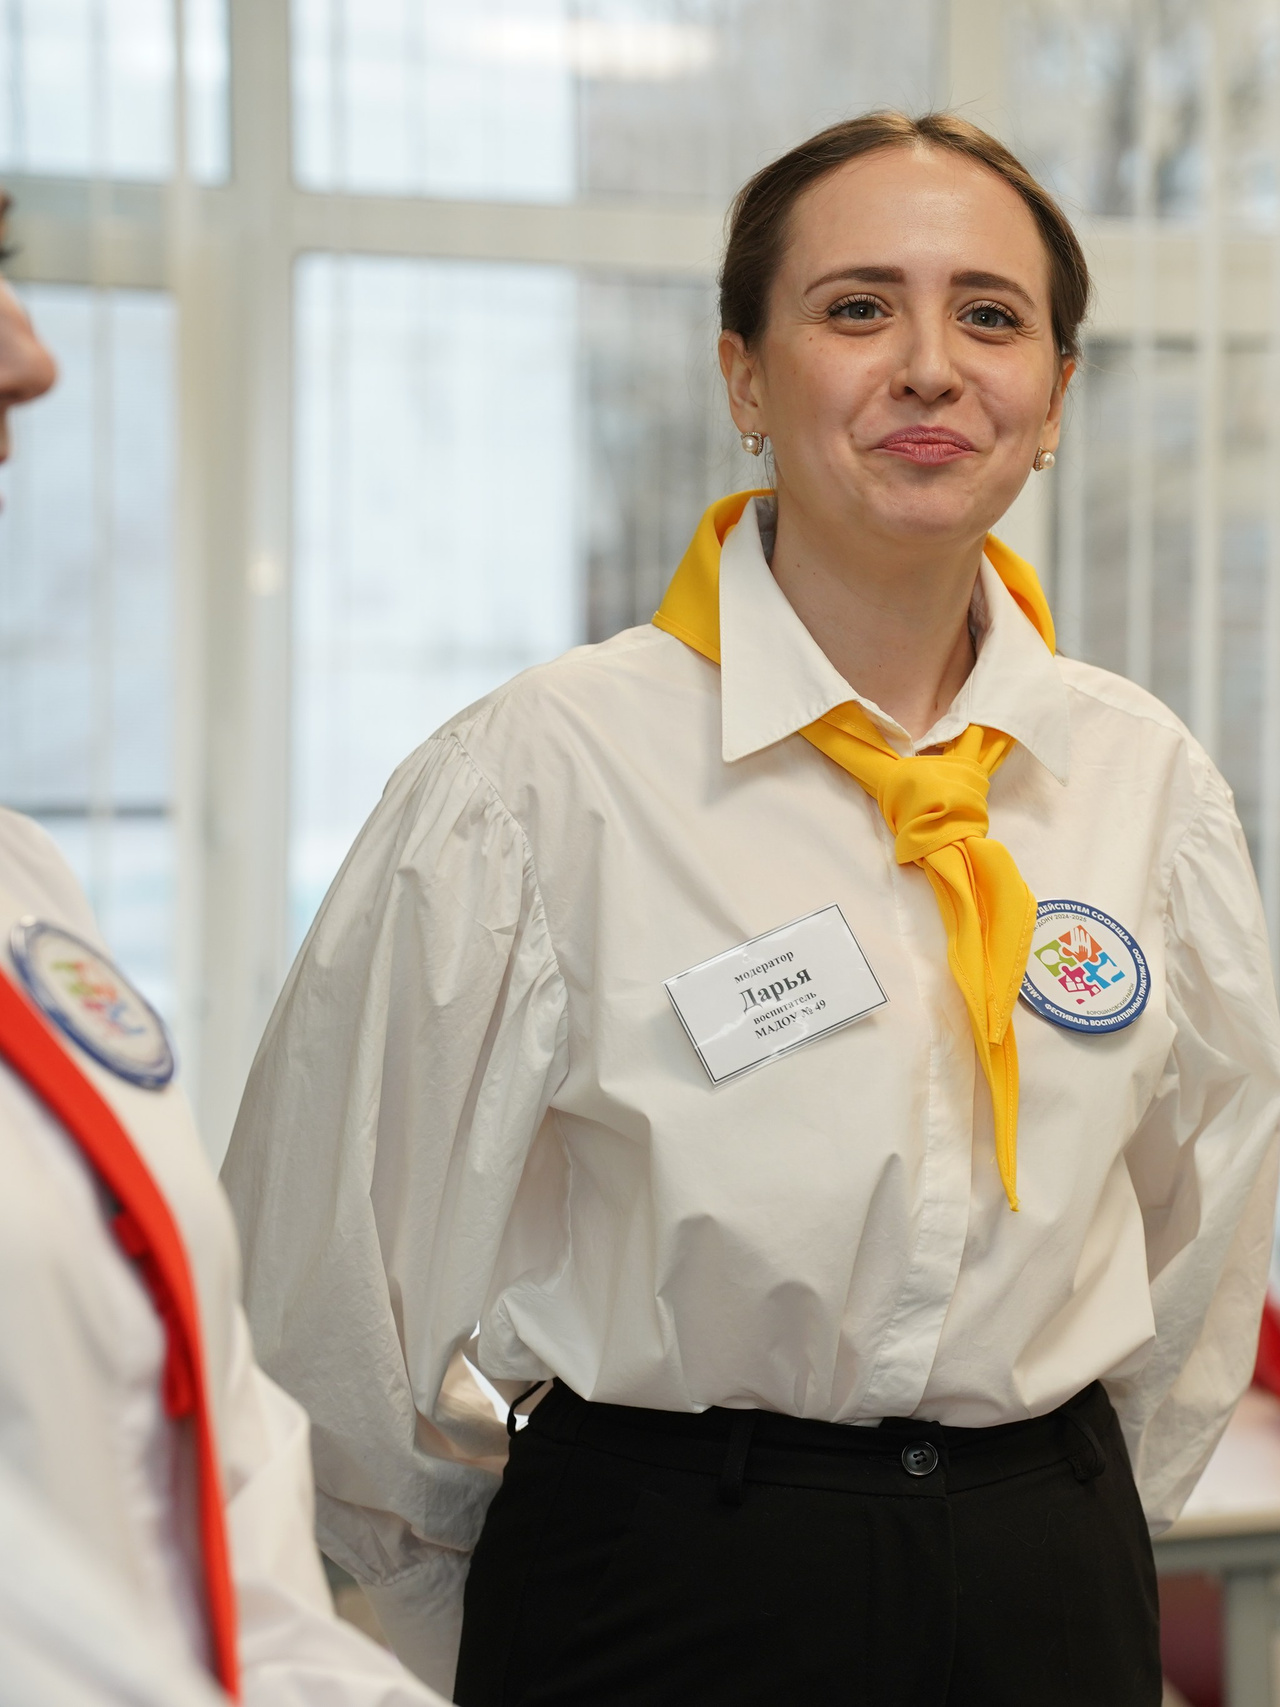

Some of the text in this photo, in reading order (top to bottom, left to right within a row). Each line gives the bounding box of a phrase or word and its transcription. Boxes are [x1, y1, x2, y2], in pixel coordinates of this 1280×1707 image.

[1091, 911, 1131, 946] СООБЩА»
[734, 950, 794, 984] модератор
[739, 968, 812, 1014] Дарья
[753, 991, 817, 1025] воспитатель
[1044, 1003, 1090, 1026] ФЕСТИВАЛЬ
[1090, 995, 1143, 1027] ВОСПИТАТЕЛЬНЫХ
[1138, 965, 1147, 998] ПРАКТИК
[755, 1014, 799, 1040] МАДОУ
[814, 999, 827, 1011] 49
